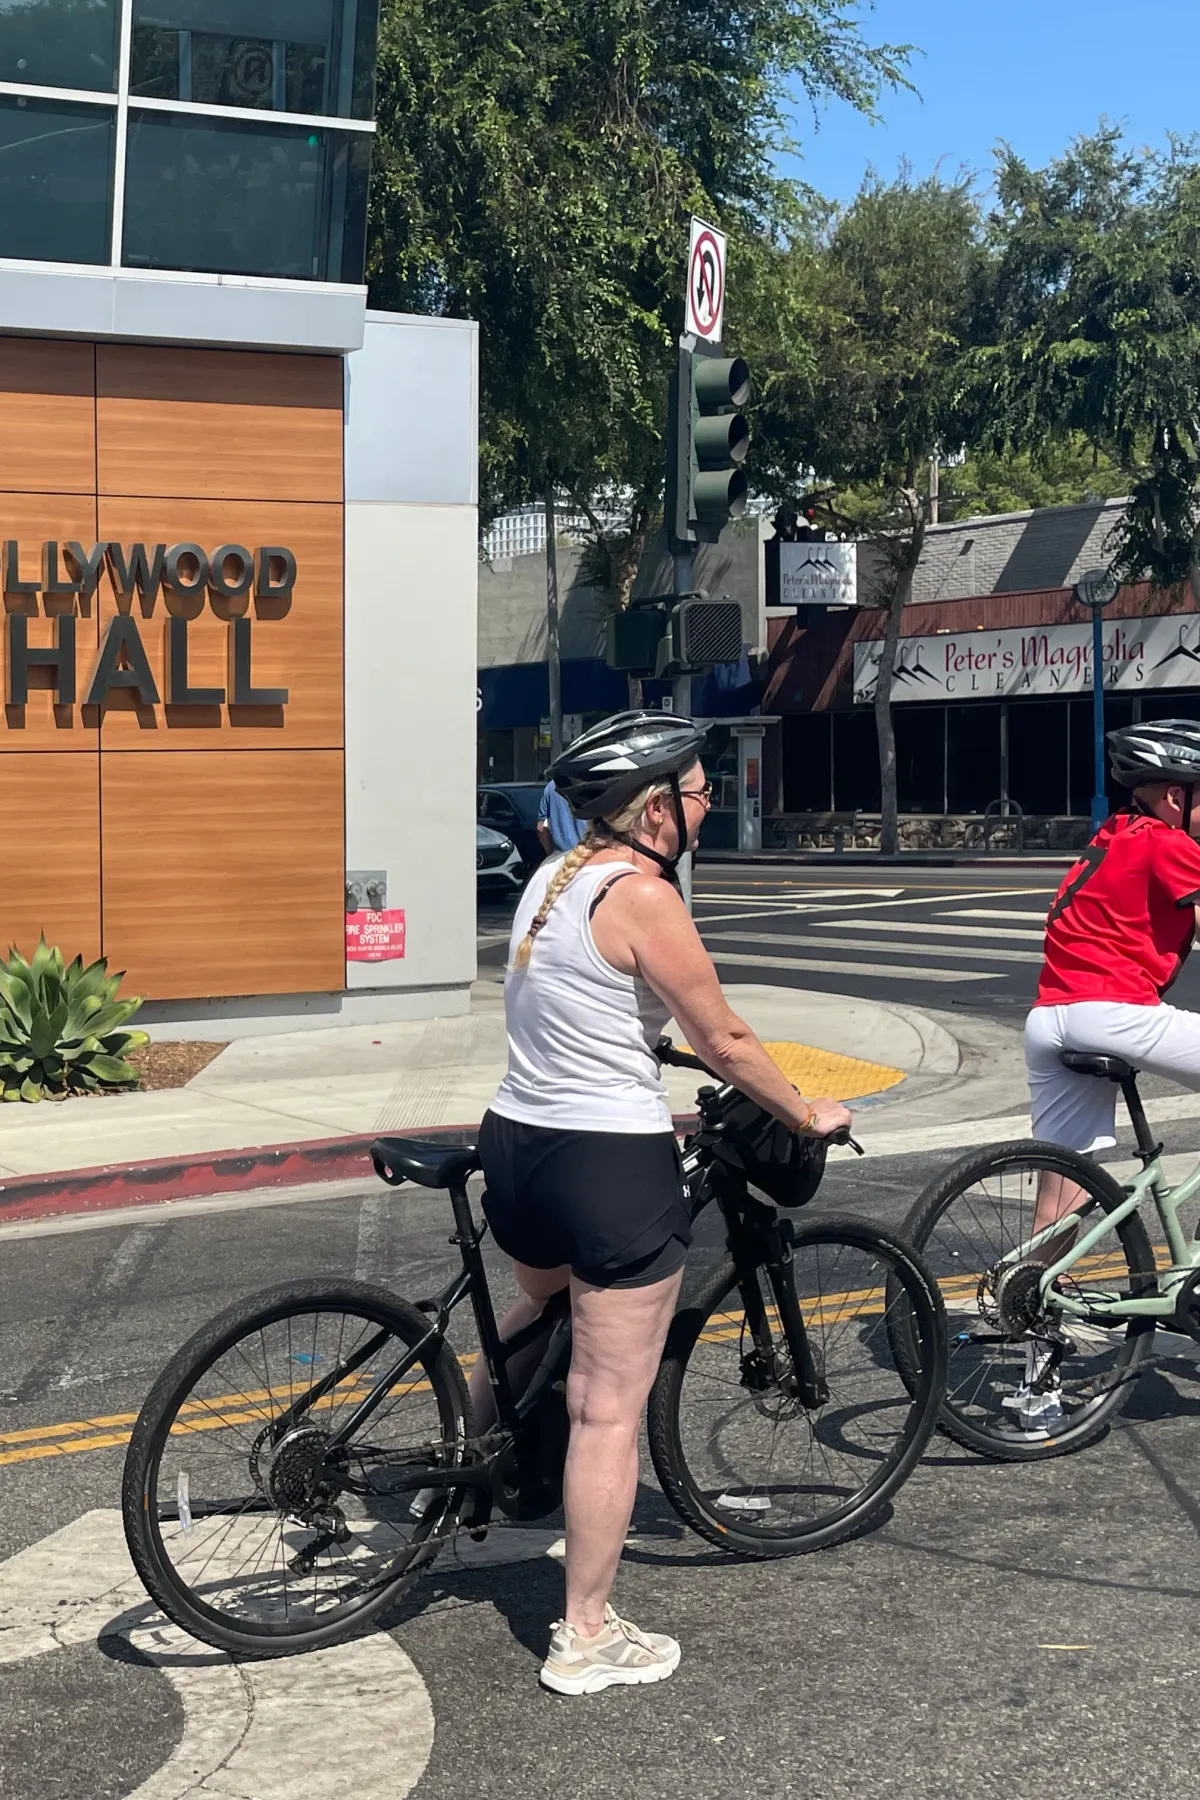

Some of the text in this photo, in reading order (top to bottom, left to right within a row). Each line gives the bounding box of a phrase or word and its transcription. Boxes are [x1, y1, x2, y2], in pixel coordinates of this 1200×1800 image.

[4, 612, 290, 706] HALL
[945, 638, 1014, 672] Peter's
[945, 663, 1145, 692] CLEANERS
[366, 912, 382, 923] FDC
[346, 923, 404, 935] FIRE SPRINKLER
[360, 934, 390, 945] SYSTEM
